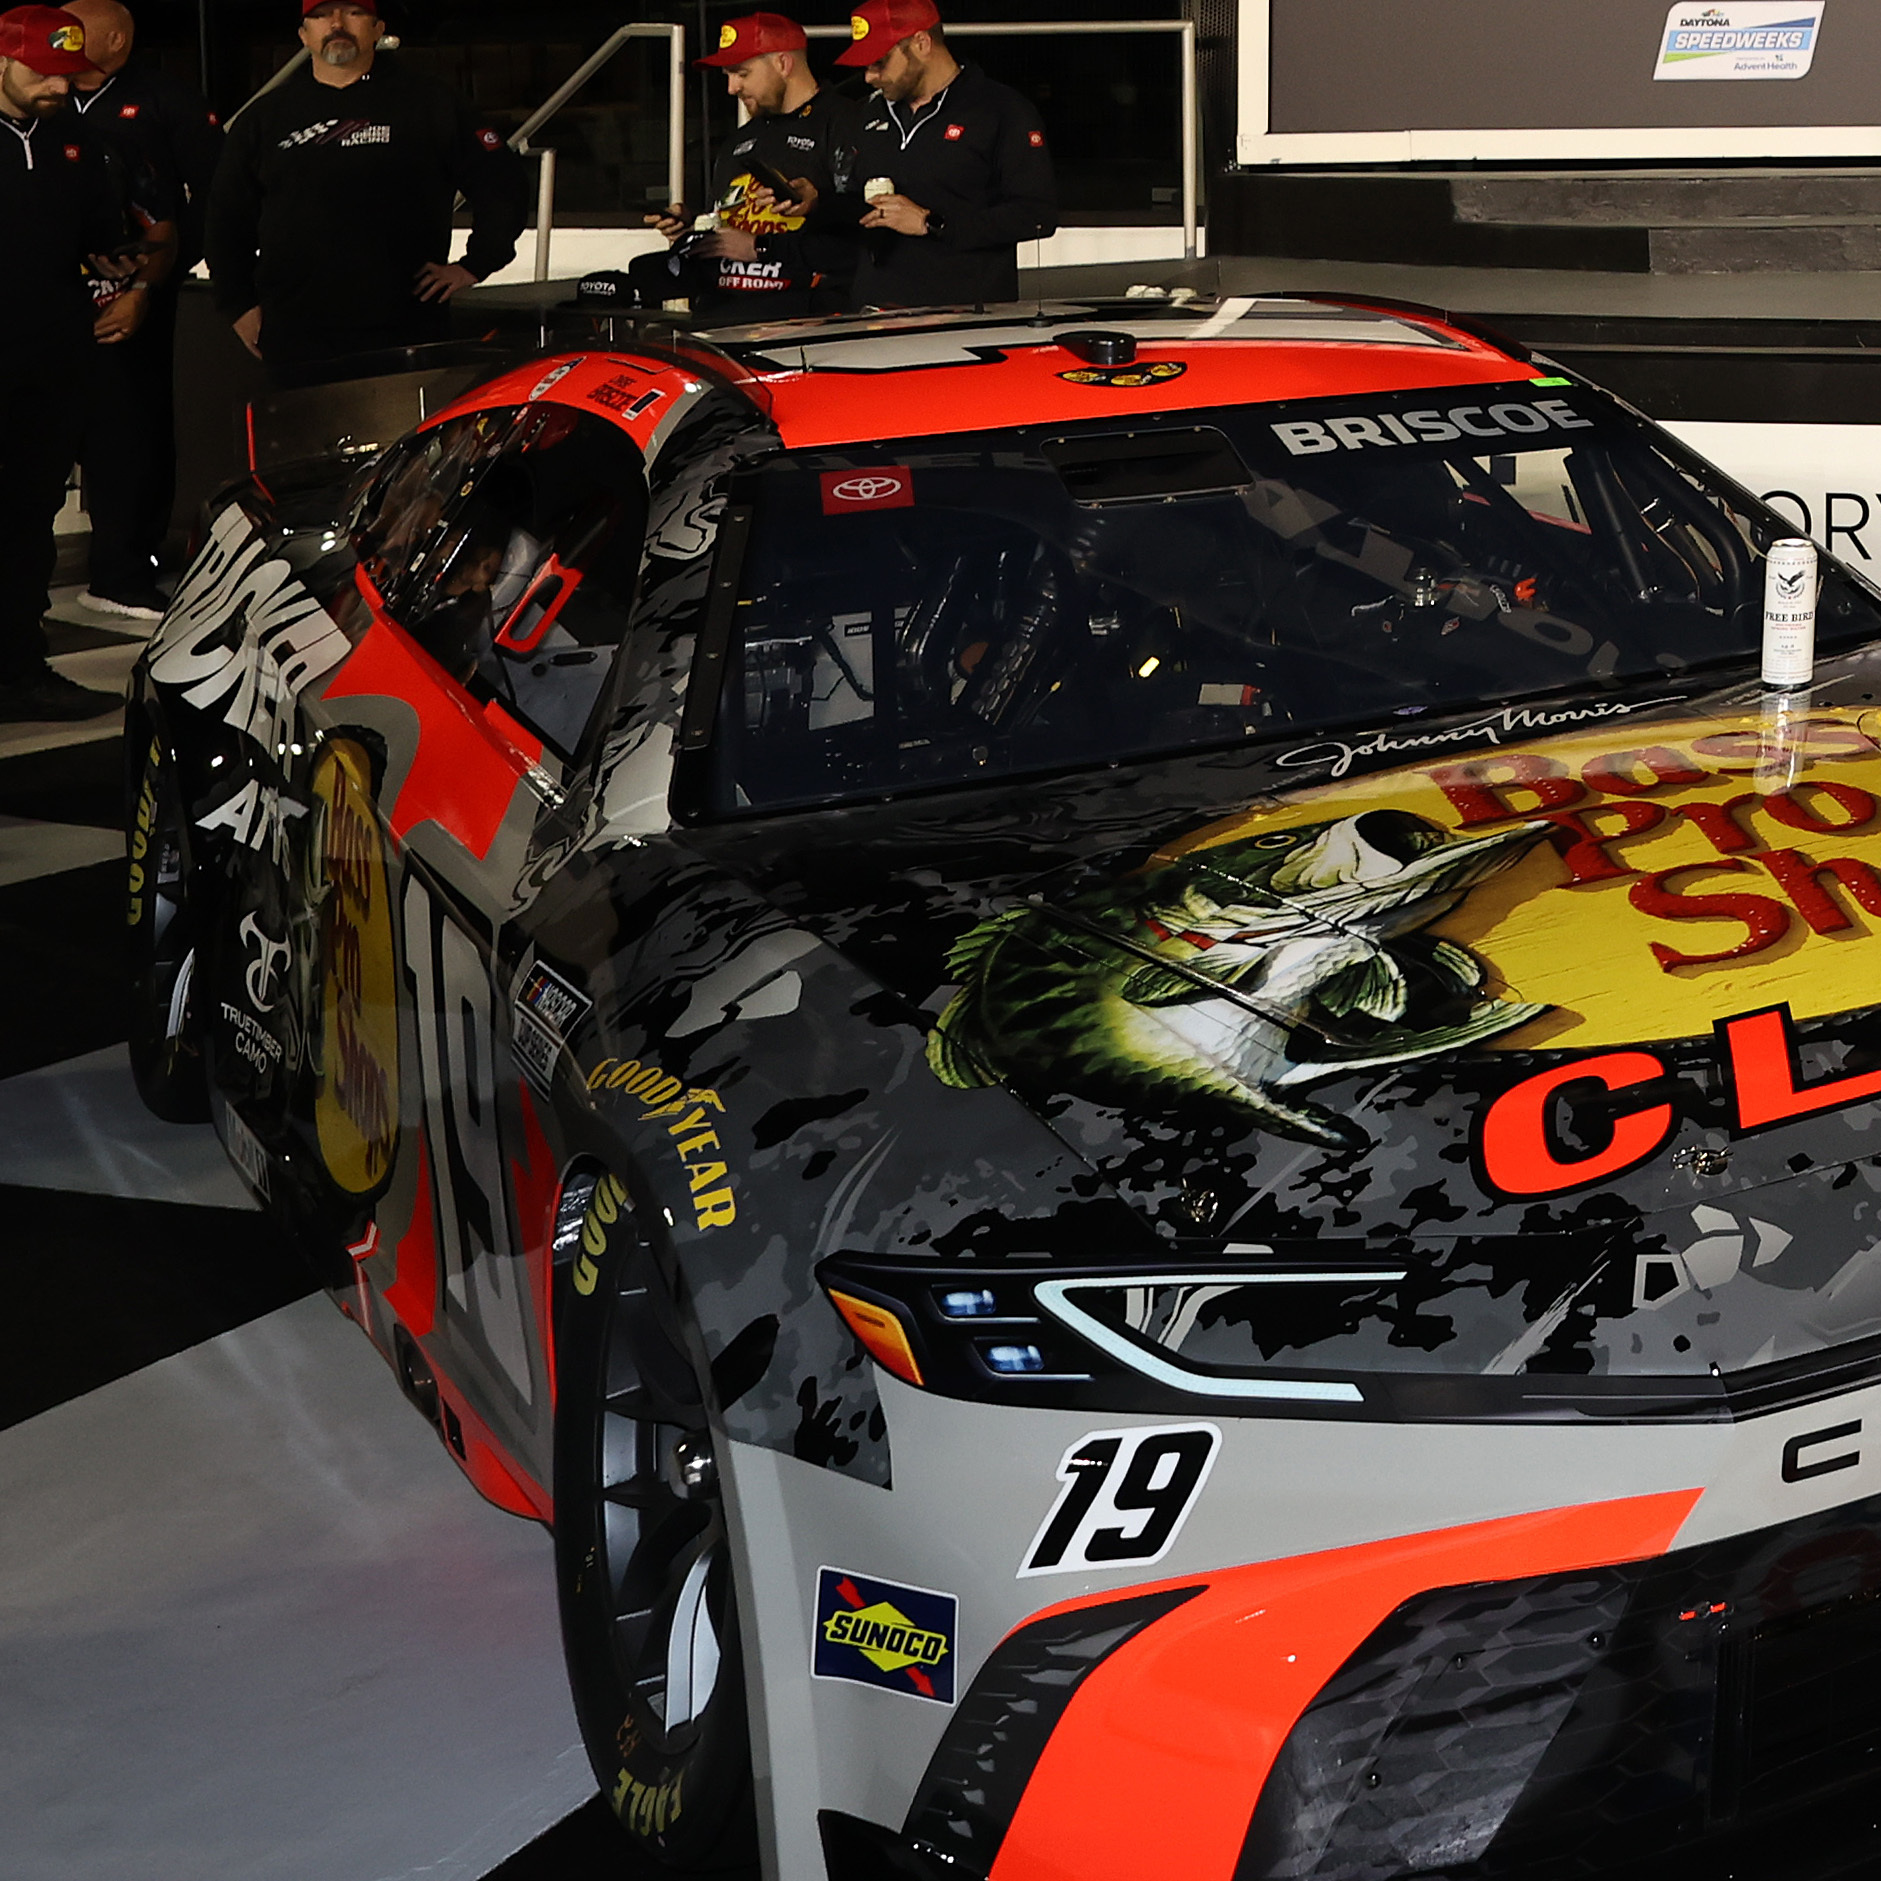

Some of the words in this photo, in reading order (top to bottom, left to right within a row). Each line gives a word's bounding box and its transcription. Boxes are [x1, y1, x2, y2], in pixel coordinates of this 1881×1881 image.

[1675, 31, 1802, 50] SPEEDWEEKS
[1680, 18, 1730, 27] DAYTONA
[1270, 401, 1594, 456] BRISCOE
[1765, 610, 1788, 622] FREE
[1791, 610, 1814, 622] BIRD
[1277, 711, 1502, 775] Johnny
[1503, 695, 1680, 744] Morris
[1424, 718, 1878, 832] Bass
[221, 1002, 284, 1064] TRUETIMBER
[235, 1032, 267, 1075] CAMO
[589, 1057, 738, 1232] GOODYEAR
[1029, 1429, 1211, 1571] 19
[828, 1611, 950, 1666] SUNOCO
